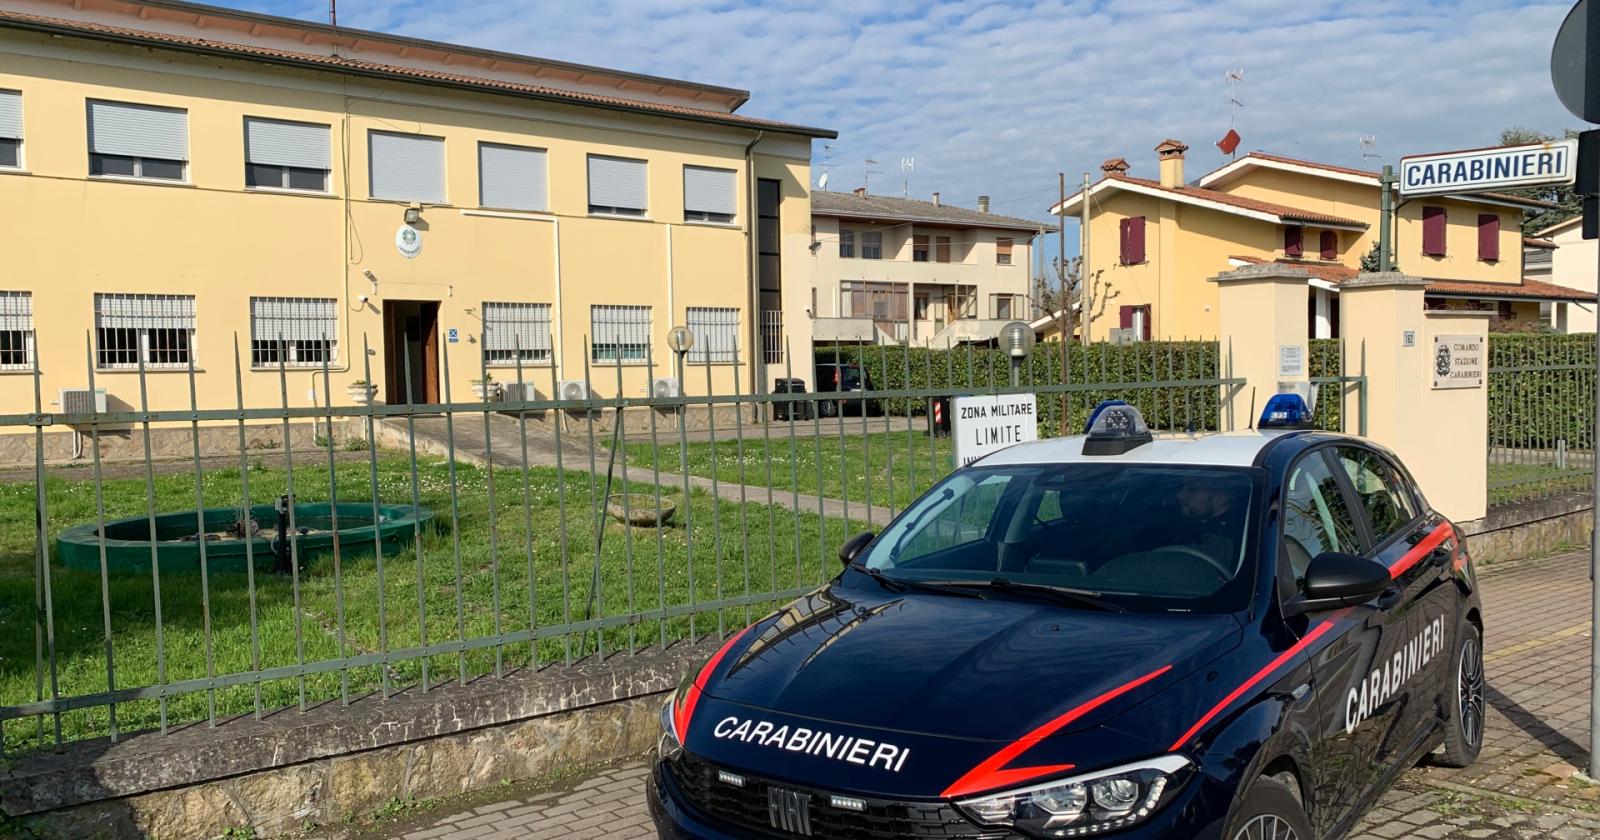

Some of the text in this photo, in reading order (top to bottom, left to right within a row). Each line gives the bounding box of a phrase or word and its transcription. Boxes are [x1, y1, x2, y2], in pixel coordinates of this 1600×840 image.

[1407, 150, 1563, 187] CARABINIERI
[1453, 343, 1480, 351] COMANDO
[1454, 357, 1478, 366] STAZIONE
[1450, 370, 1482, 379] CARABINIERI
[961, 403, 1033, 419] ZONA MILITARE
[975, 424, 1022, 446] LIMITE
[1345, 613, 1445, 735] CARABINIERI
[713, 715, 911, 773] CARABINIERI
[768, 786, 813, 837] FIAT
